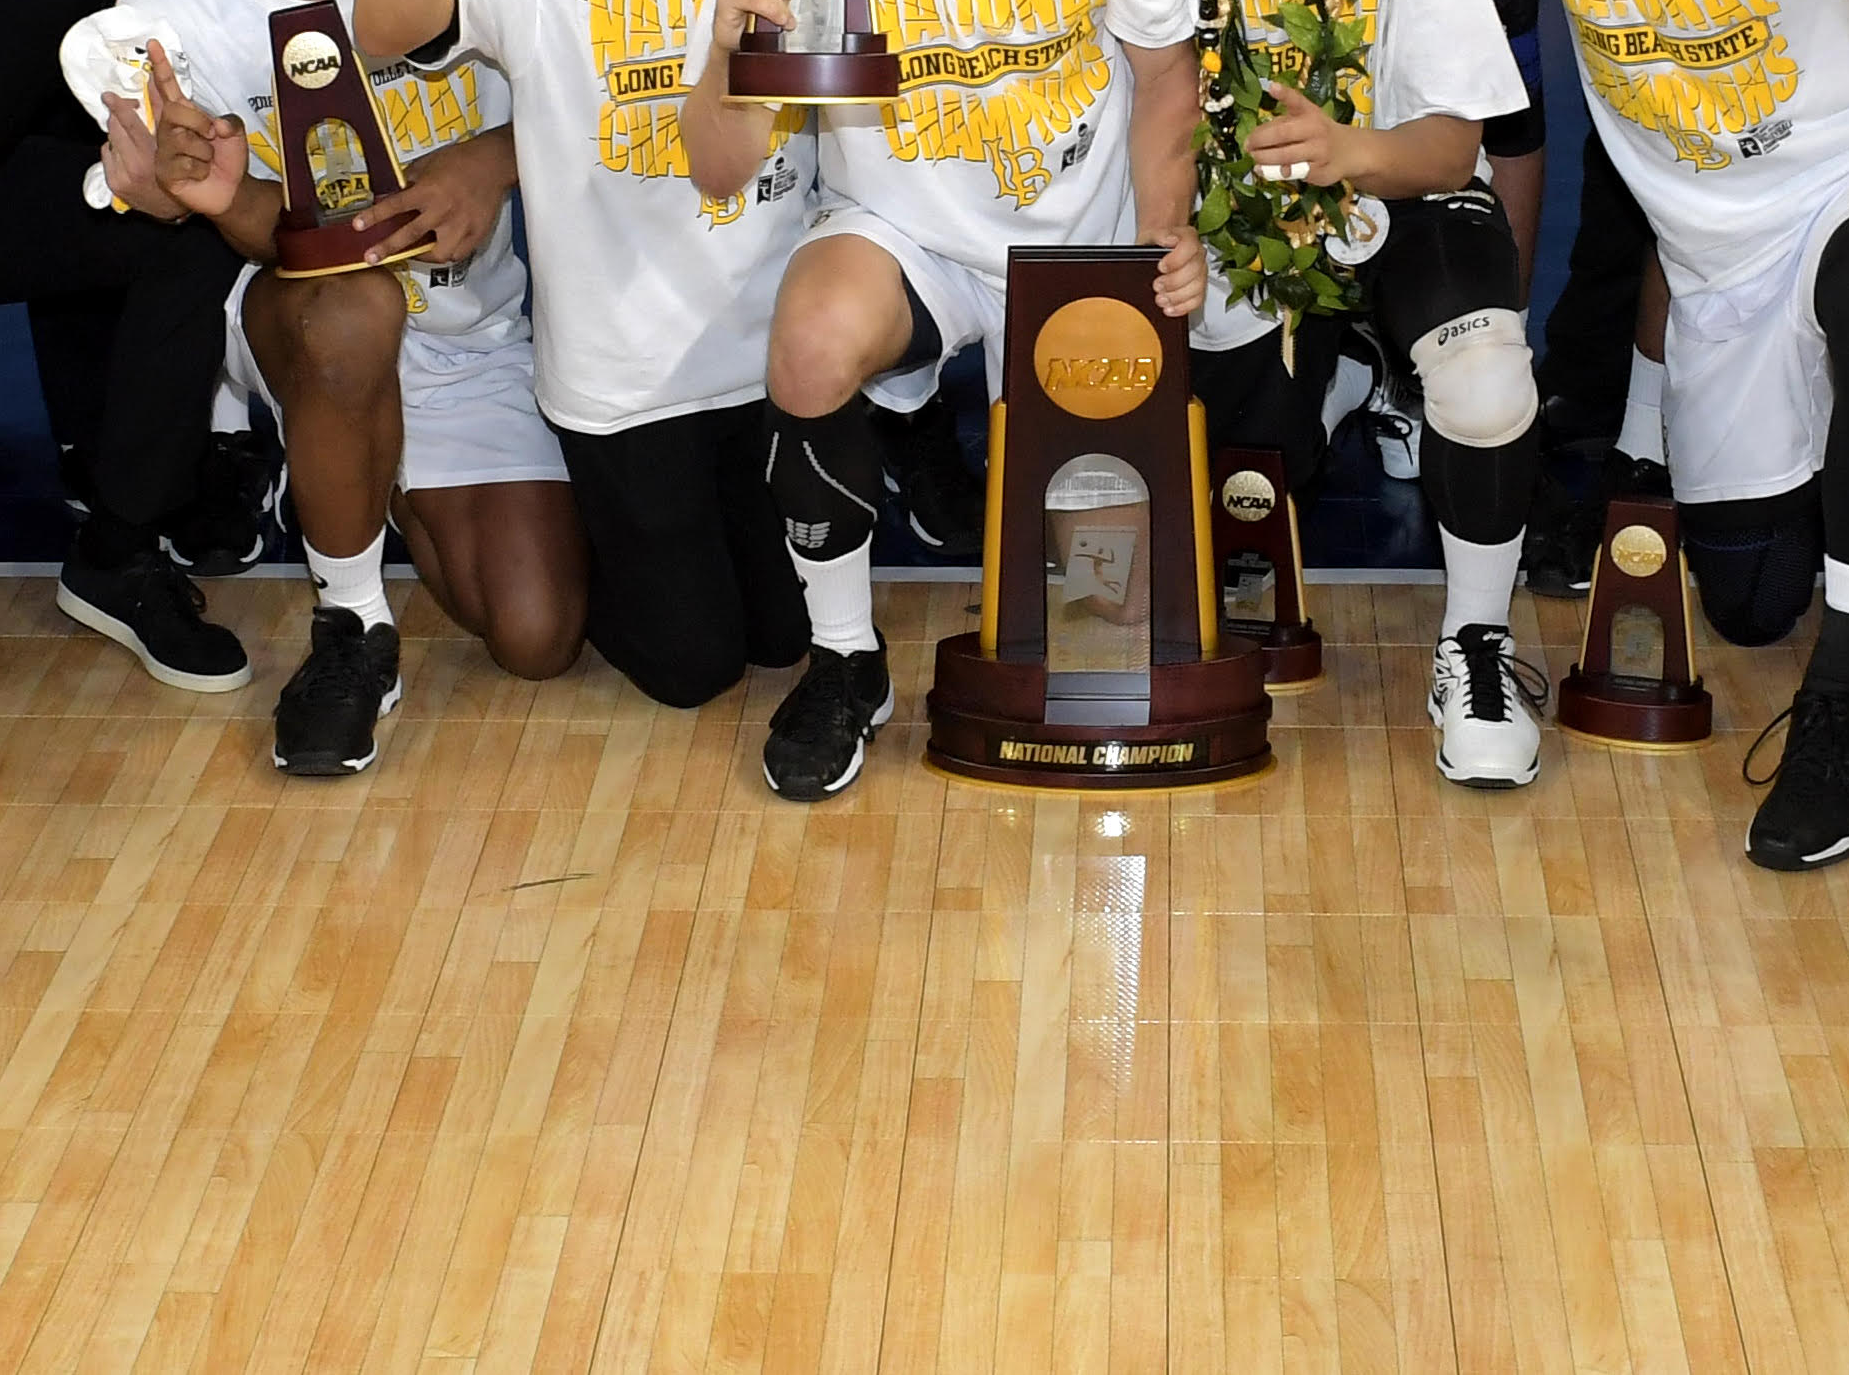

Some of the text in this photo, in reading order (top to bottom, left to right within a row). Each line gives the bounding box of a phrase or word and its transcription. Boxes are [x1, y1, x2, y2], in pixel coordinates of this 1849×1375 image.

[1686, 25, 1758, 64] STATE
[291, 55, 341, 78] NCAA
[897, 52, 960, 82] LONG
[958, 44, 1020, 80] BEACH
[614, 64, 672, 96] LONG
[1450, 316, 1491, 338] asics
[1044, 356, 1158, 392] NCAA
[1227, 496, 1273, 513] NCAA
[998, 740, 1195, 766] NATIONAL CHAMPION
